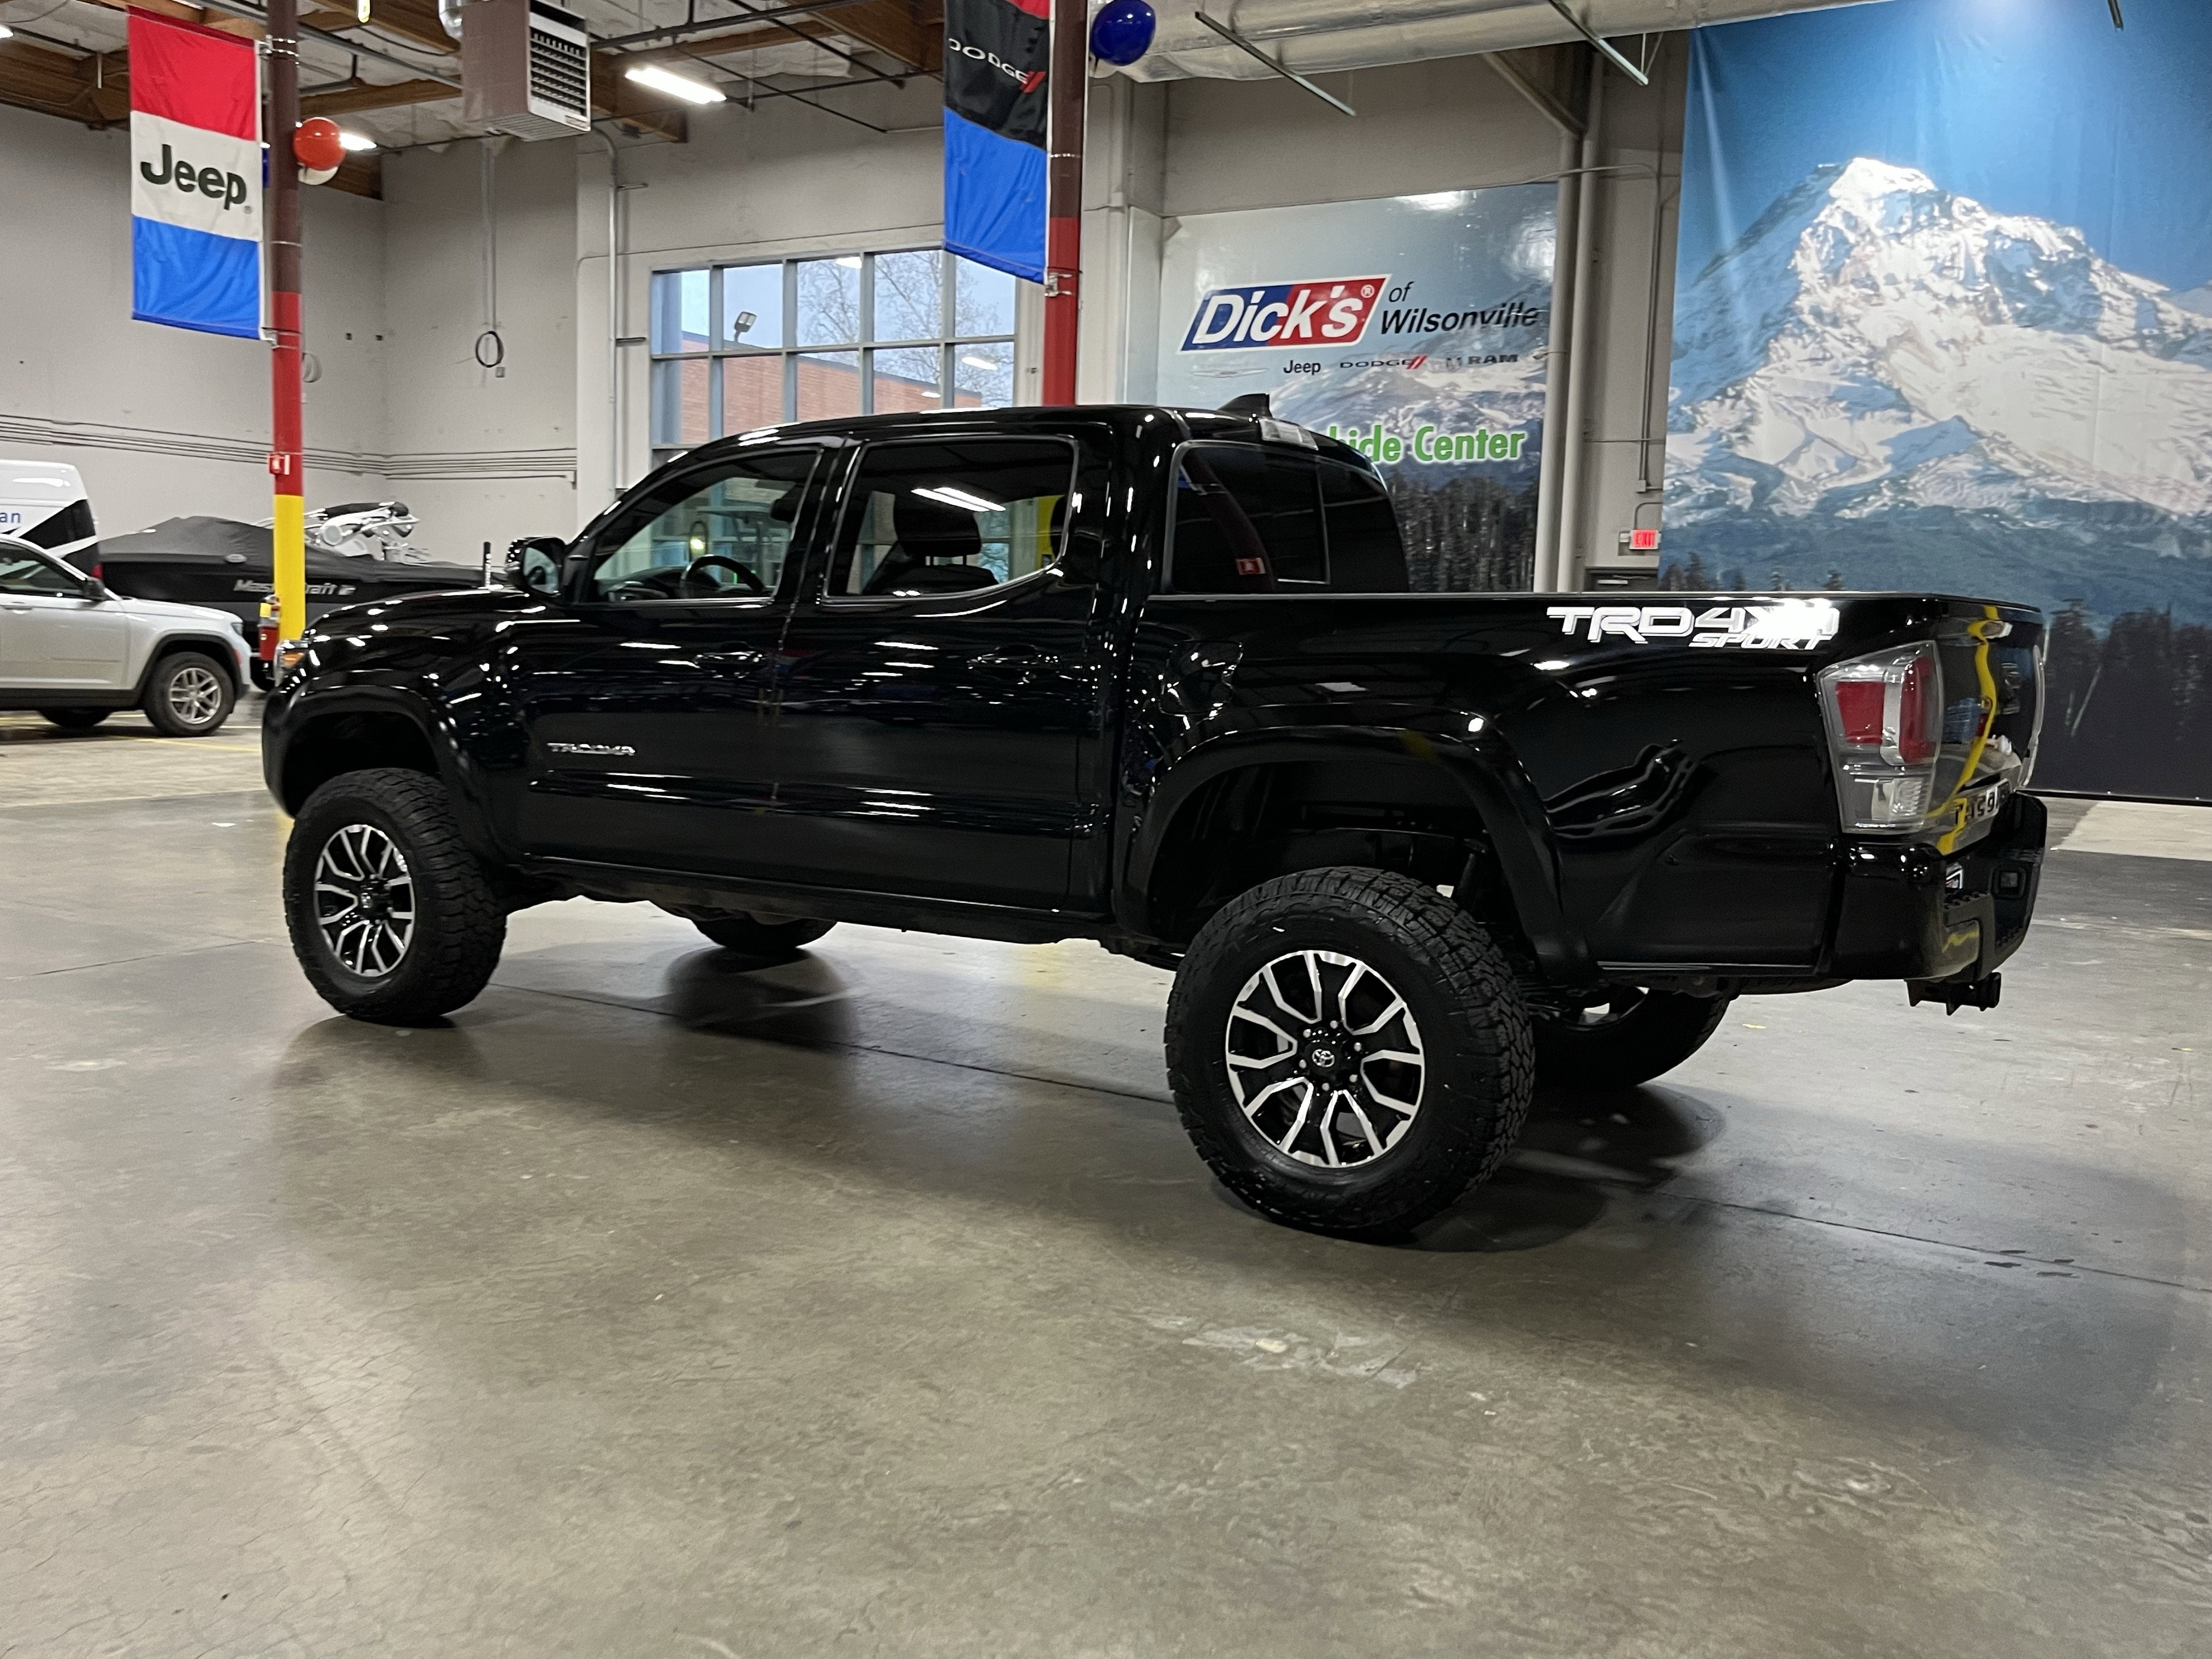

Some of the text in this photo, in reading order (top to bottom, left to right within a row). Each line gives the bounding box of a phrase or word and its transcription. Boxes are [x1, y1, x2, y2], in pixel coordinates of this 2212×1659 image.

[948, 37, 1030, 84] DODGE
[140, 143, 247, 211] Jeep
[1192, 281, 1415, 345] Dick's of
[1380, 301, 1539, 335] Wilsonville
[1283, 359, 1322, 375] Jeep
[1340, 359, 1413, 369] DODGE
[1468, 353, 1519, 365] RAM
[1414, 426, 1526, 461] Center
[1634, 531, 1656, 547] EXIT
[1547, 606, 1695, 644] TRD
[1688, 632, 1834, 650] SPORT
